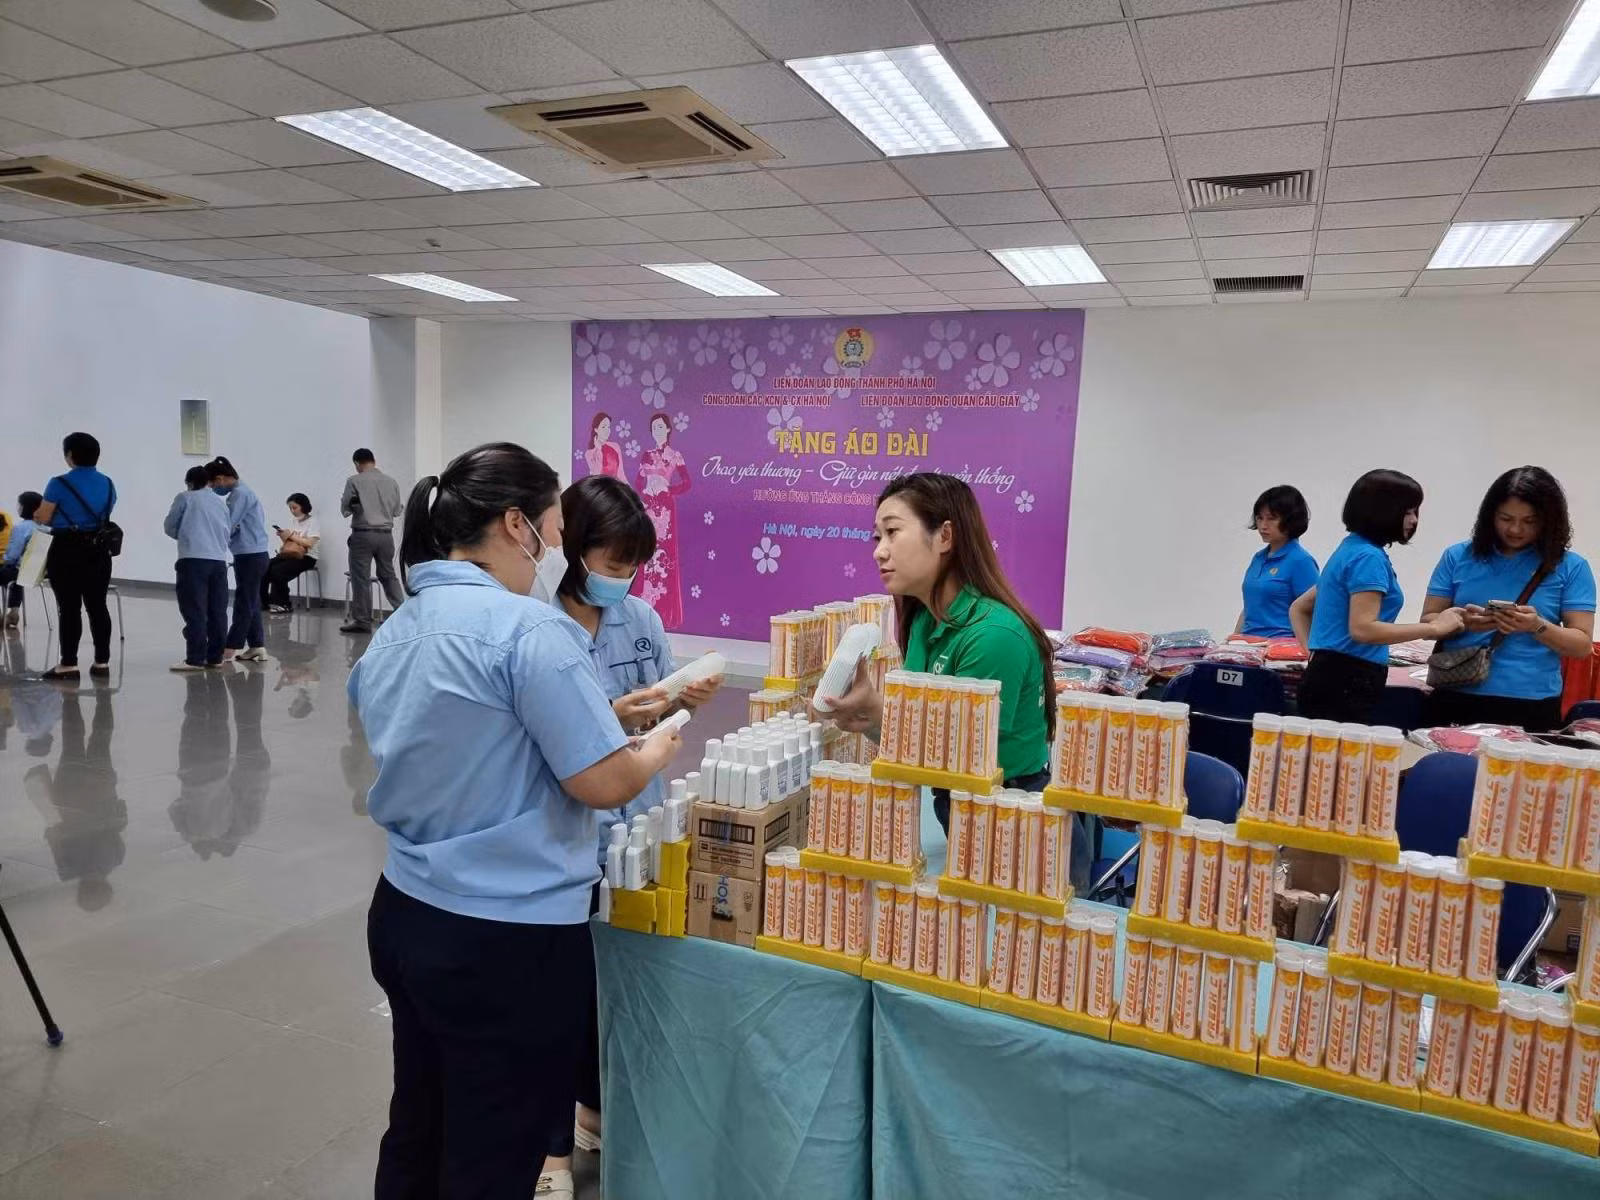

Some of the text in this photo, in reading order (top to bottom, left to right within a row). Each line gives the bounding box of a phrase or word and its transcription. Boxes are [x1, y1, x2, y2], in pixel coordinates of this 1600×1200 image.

[816, 377, 831, 389] LAO
[764, 395, 780, 406] KCN
[782, 396, 788, 406] &
[790, 395, 801, 406] CX
[907, 395, 922, 407] LAO
[775, 426, 929, 459] TẶNG ÁO DÀI
[702, 455, 736, 478] Trao
[731, 463, 760, 484] yêu
[760, 461, 802, 486] thương
[819, 460, 858, 487] Giữ
[850, 465, 878, 489] gìn
[973, 465, 1015, 494] thống
[763, 523, 777, 534] Hà
[800, 525, 826, 539] ngày
[826, 526, 840, 538] 20
[842, 527, 871, 542] tháng
[1222, 671, 1238, 682] D7
[1382, 890, 1391, 902] C
[1412, 895, 1420, 908] C
[1475, 1028, 1484, 1041] C
[1541, 1043, 1549, 1054] C
[1582, 1055, 1592, 1067] C
[1505, 1038, 1522, 1105] FRESH C
